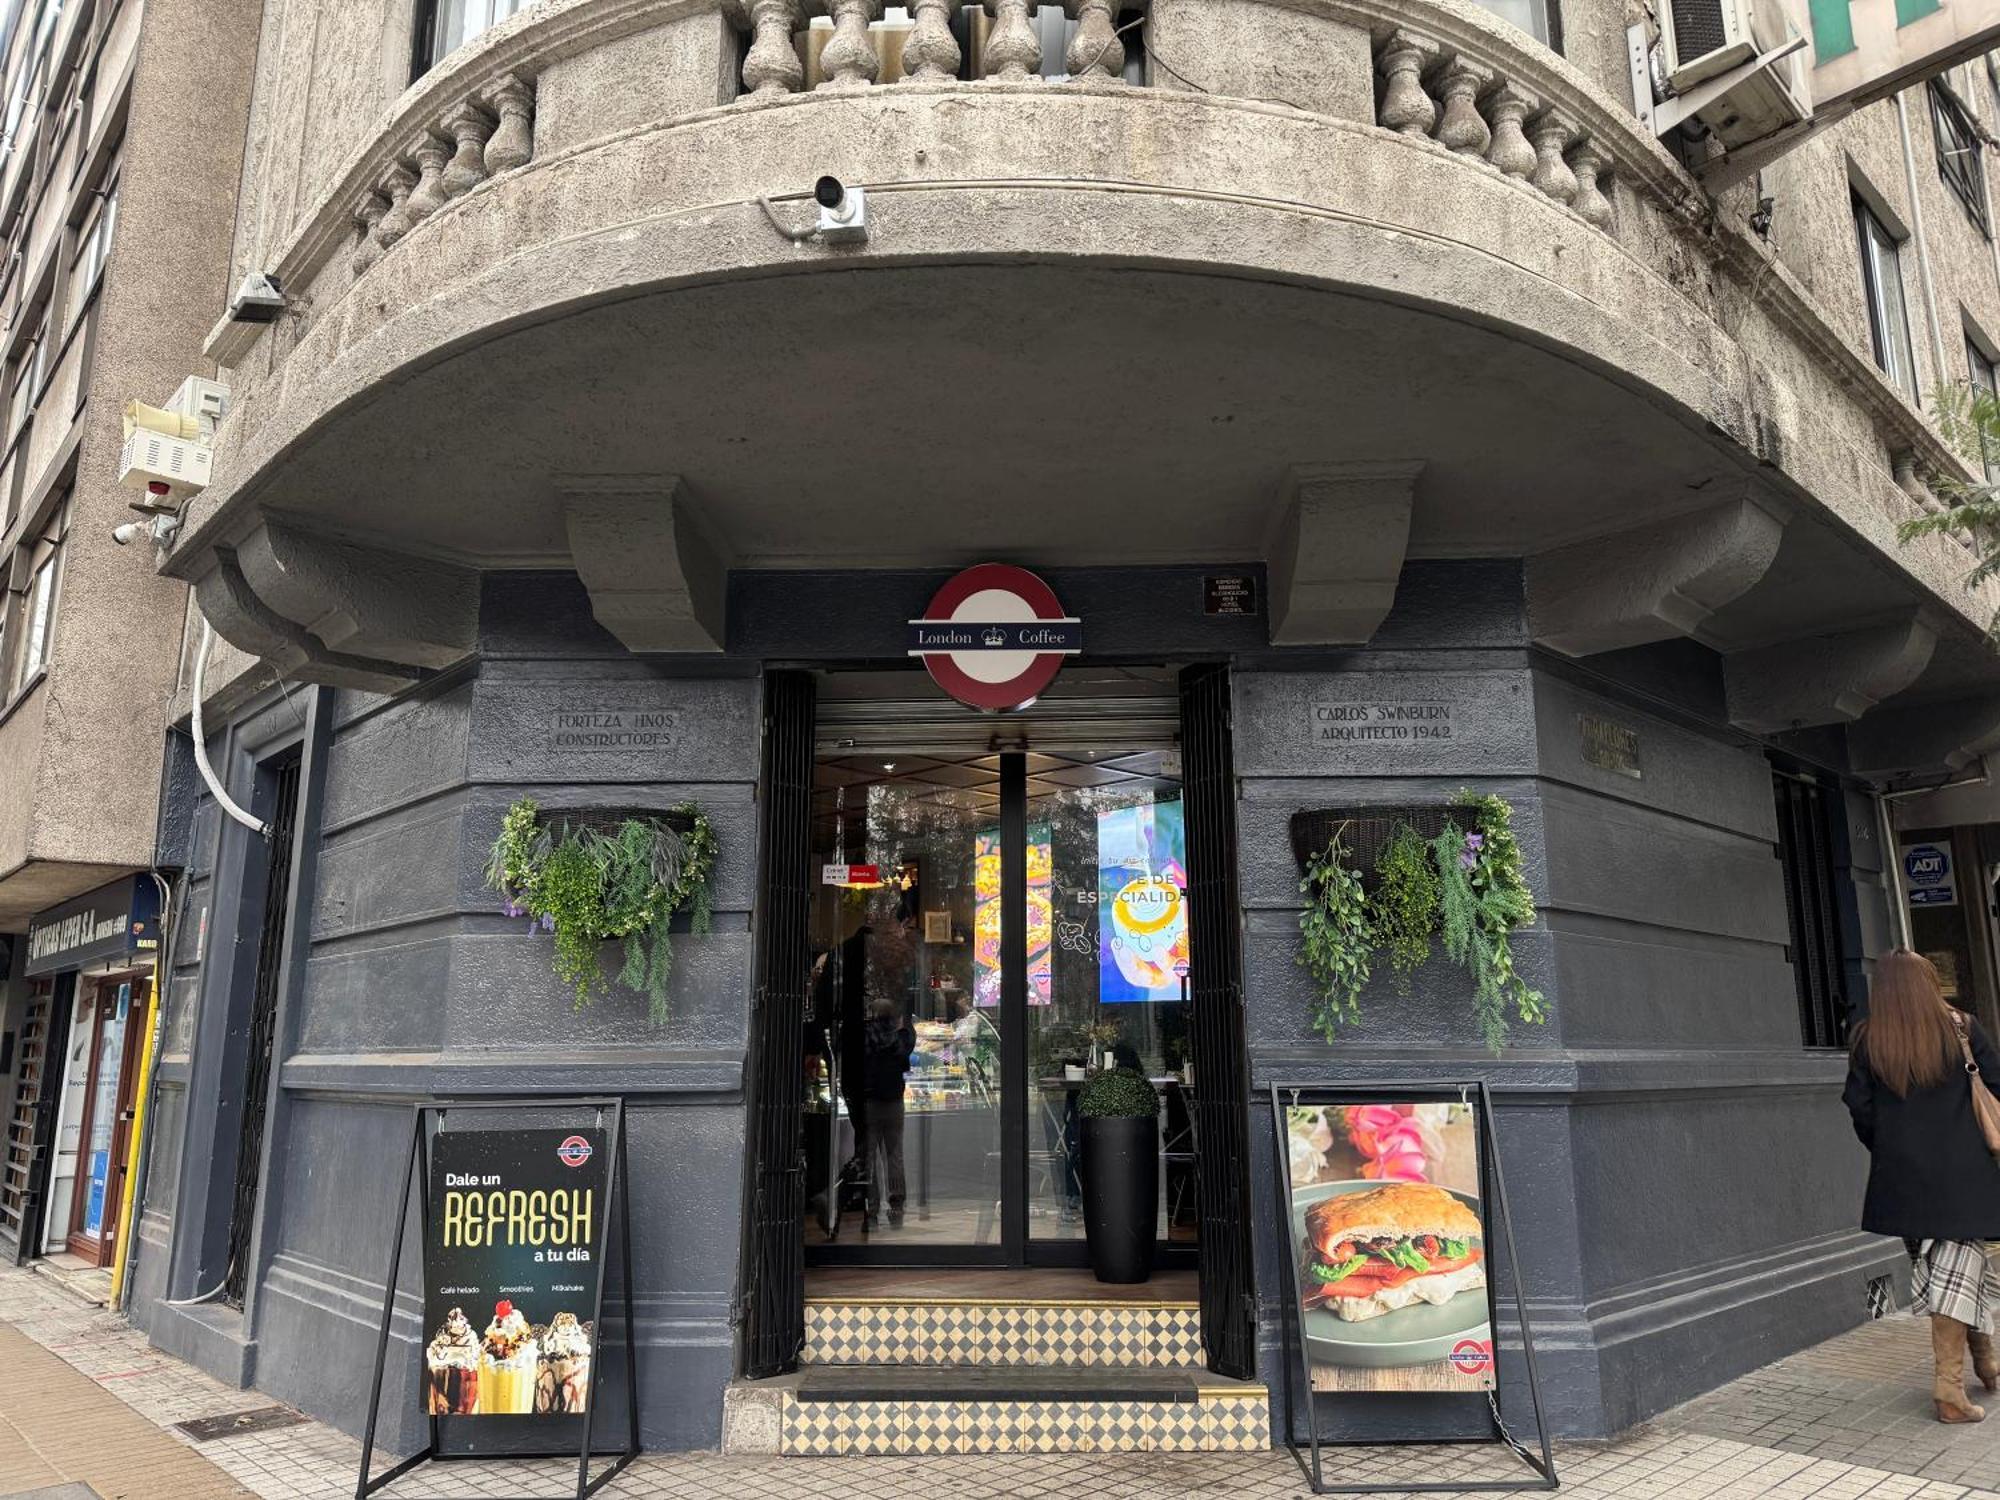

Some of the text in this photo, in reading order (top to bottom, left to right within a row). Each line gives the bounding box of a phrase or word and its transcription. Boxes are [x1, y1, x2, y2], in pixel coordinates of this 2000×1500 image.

[919, 630, 1066, 644] London Coffee
[1317, 705, 1451, 721] CARLOS SWINBURN
[558, 714, 622, 727] FORTEZA
[556, 732, 671, 746] CONSTRUCTORES
[1321, 725, 1451, 741] ARQUITECTO 1942
[1911, 858, 1941, 873] ADT
[1077, 891, 1187, 903] ESPECIALIDA
[445, 1173, 501, 1186] Dale un
[443, 1189, 592, 1247] REFRESH
[534, 1247, 590, 1262] a tu día
[457, 1285, 480, 1294] helado
[499, 1284, 534, 1293] Smoothies
